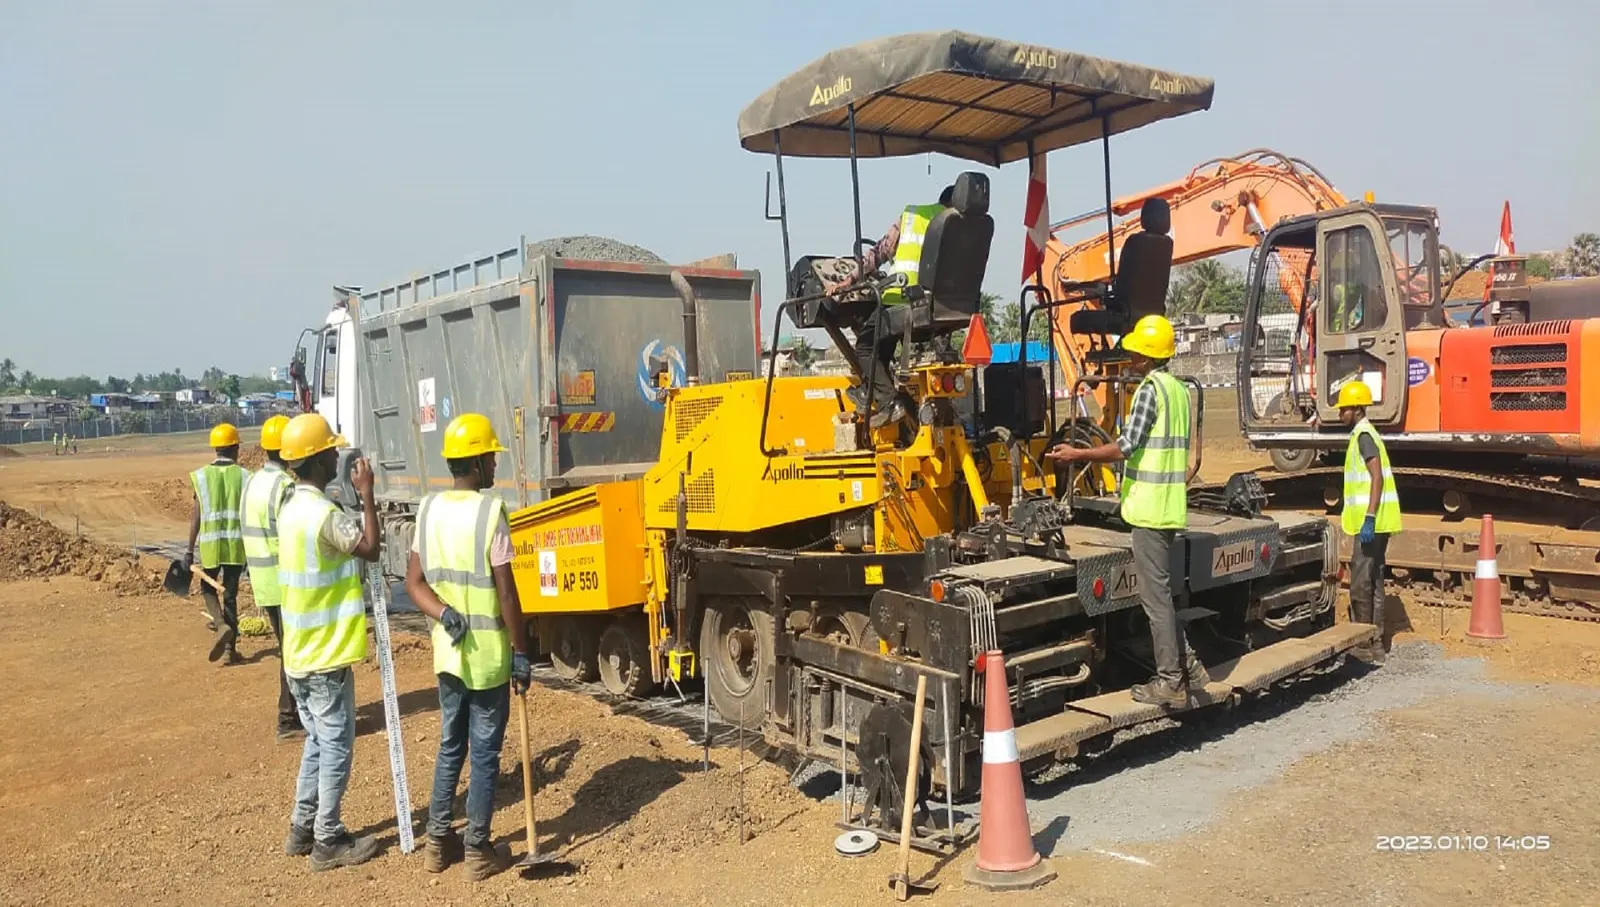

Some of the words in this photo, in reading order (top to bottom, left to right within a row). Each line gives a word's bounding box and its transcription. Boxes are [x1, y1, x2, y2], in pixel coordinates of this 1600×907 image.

[1012, 46, 1057, 70] Apollo
[809, 73, 853, 107] Apollo
[1149, 72, 1186, 96] Apollo
[761, 457, 804, 484] Apollo
[1214, 548, 1254, 572] Apollo
[563, 572, 576, 592] AP
[579, 571, 599, 591] 550
